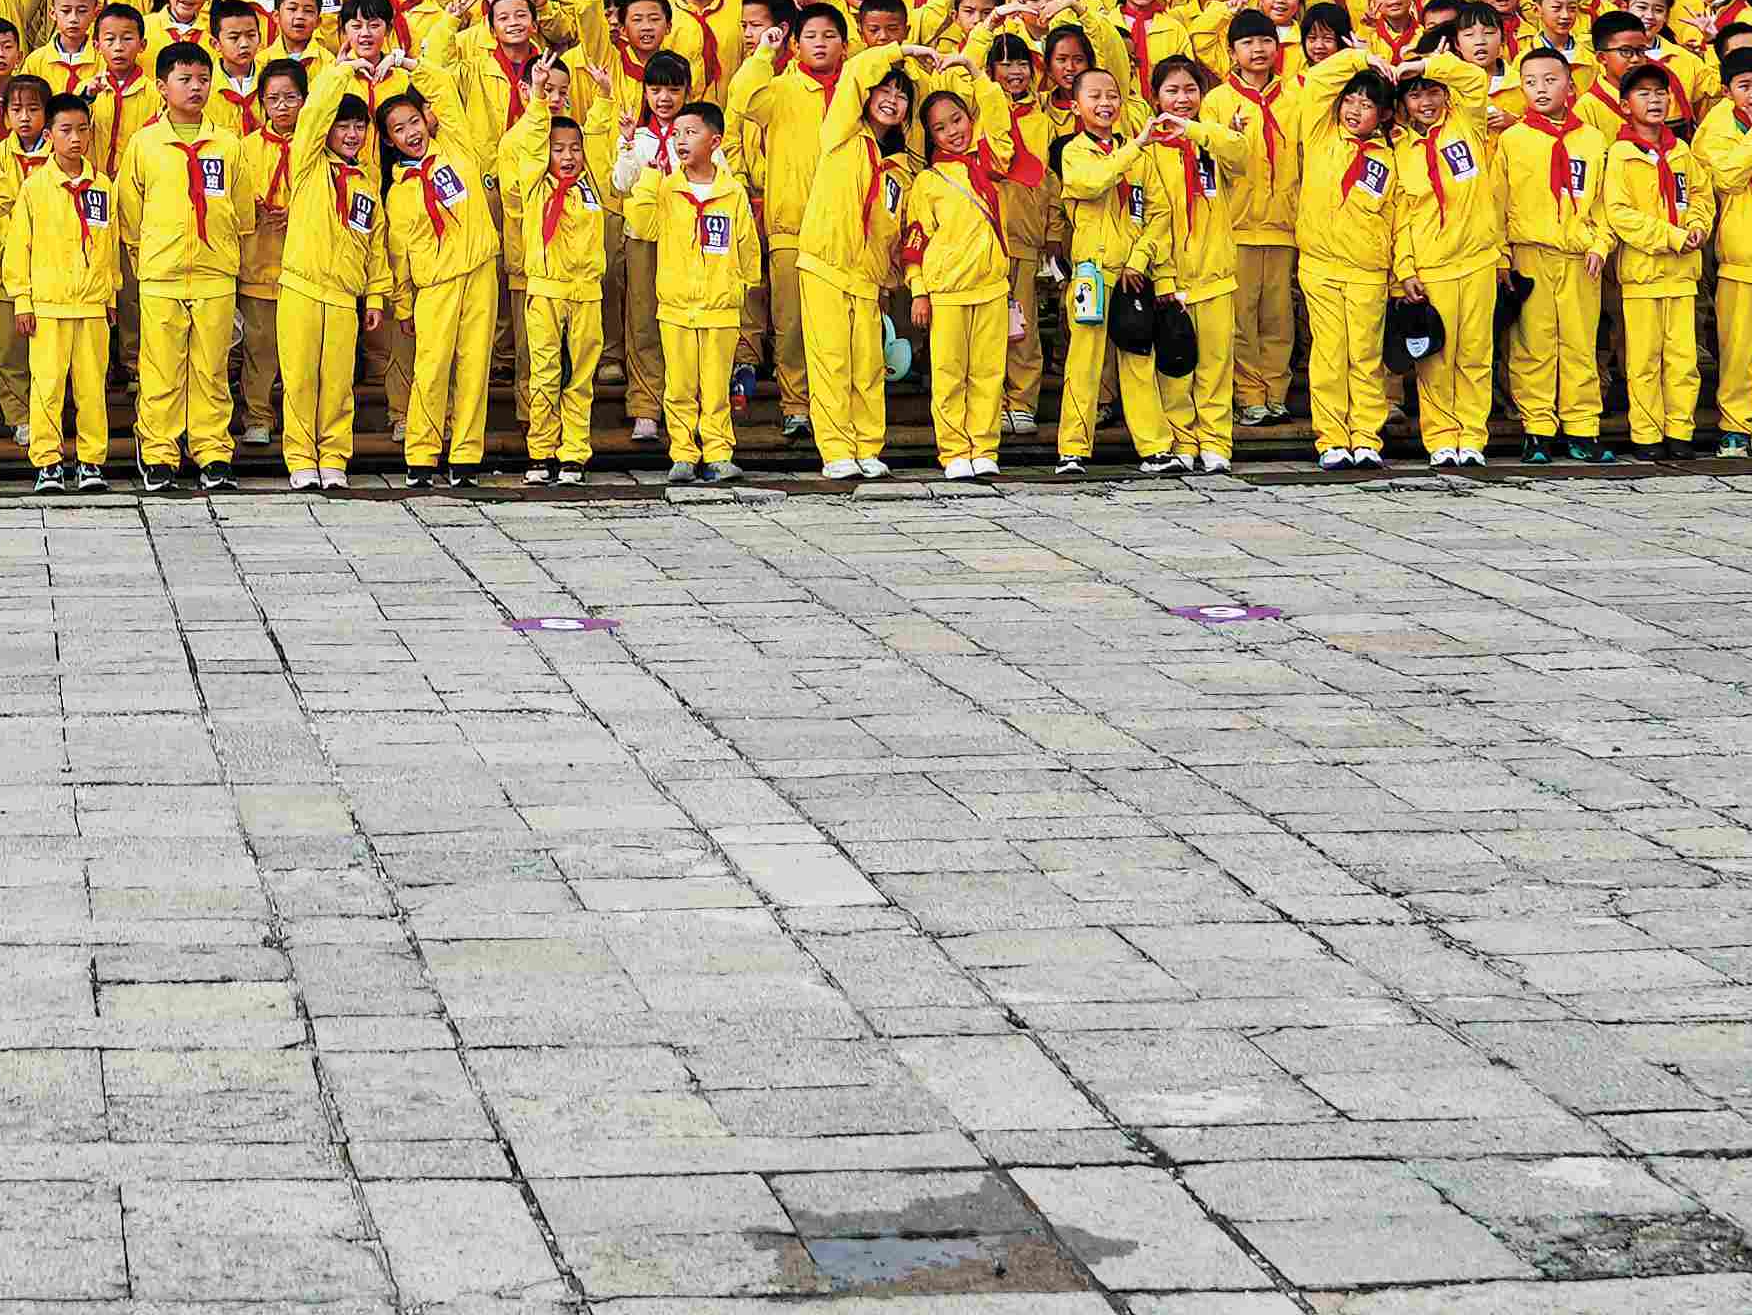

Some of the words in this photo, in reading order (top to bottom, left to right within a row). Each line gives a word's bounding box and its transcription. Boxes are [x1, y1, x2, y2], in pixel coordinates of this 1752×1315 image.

[1447, 141, 1466, 158] (1)
[203, 159, 222, 173] (1)
[1367, 159, 1384, 177] (1)
[1570, 161, 1582, 175] 1)
[435, 169, 453, 185] (1)
[88, 190, 102, 205] (1)
[356, 196, 372, 212] (1)
[707, 216, 725, 232] (1)
